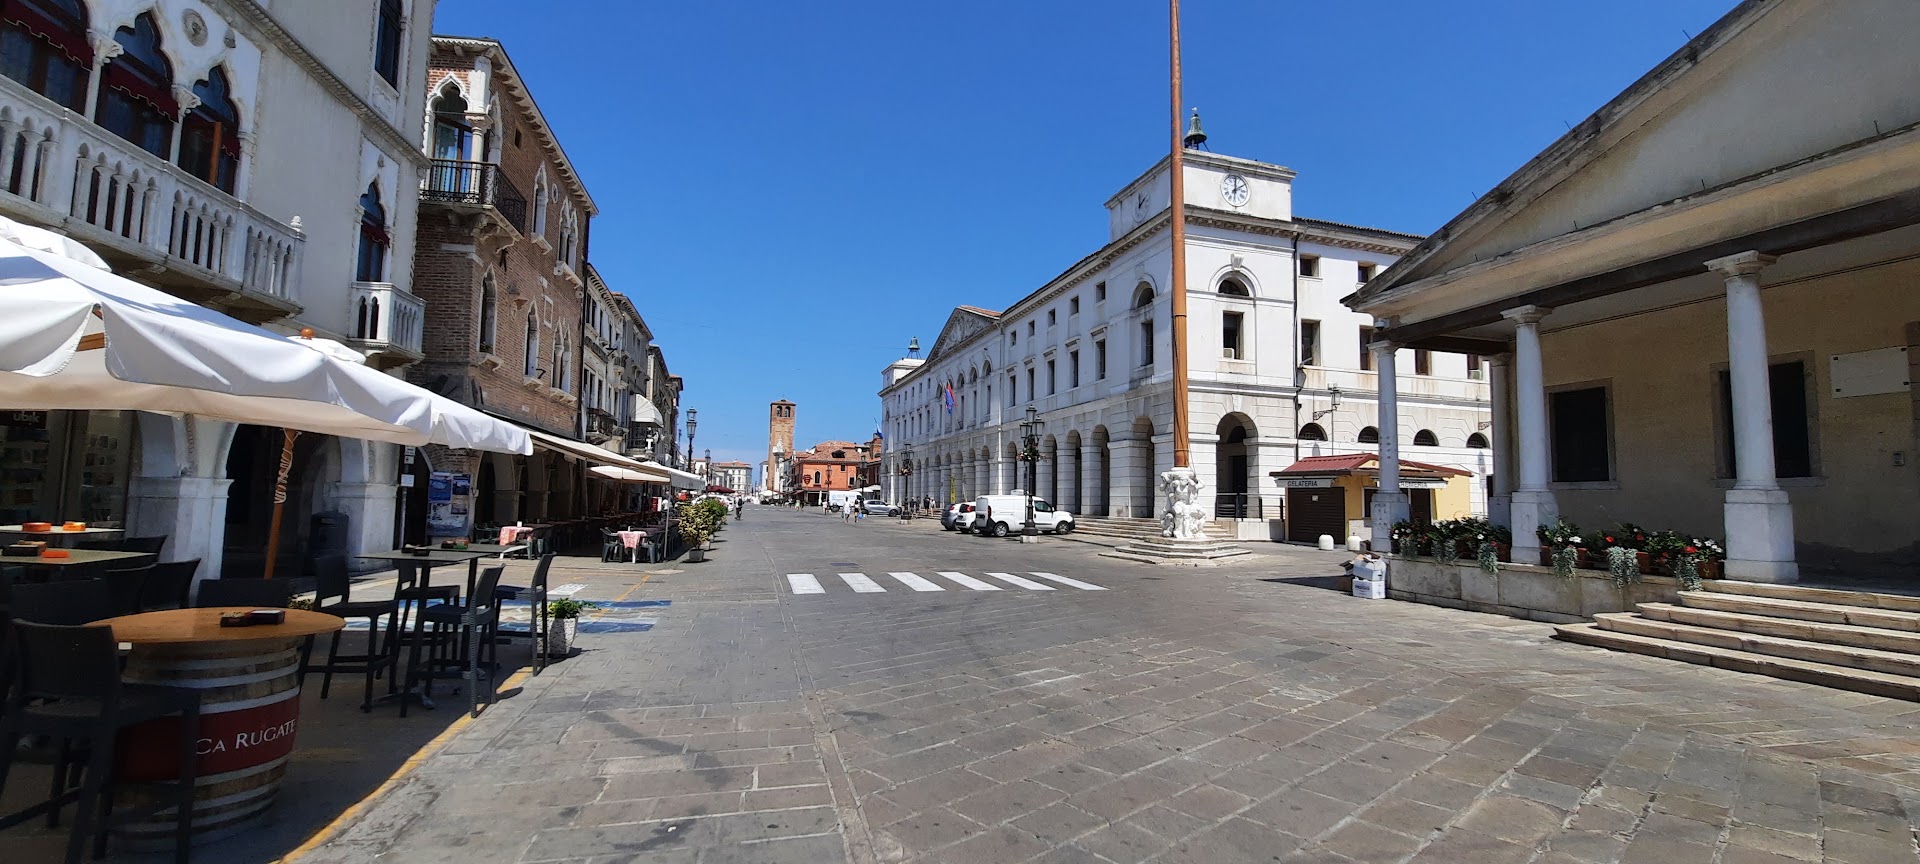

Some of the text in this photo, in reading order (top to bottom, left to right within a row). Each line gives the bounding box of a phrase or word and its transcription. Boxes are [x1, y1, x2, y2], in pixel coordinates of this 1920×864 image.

[1399, 480, 1428, 488] REMERIA
[195, 719, 296, 755] CA RUGATE
